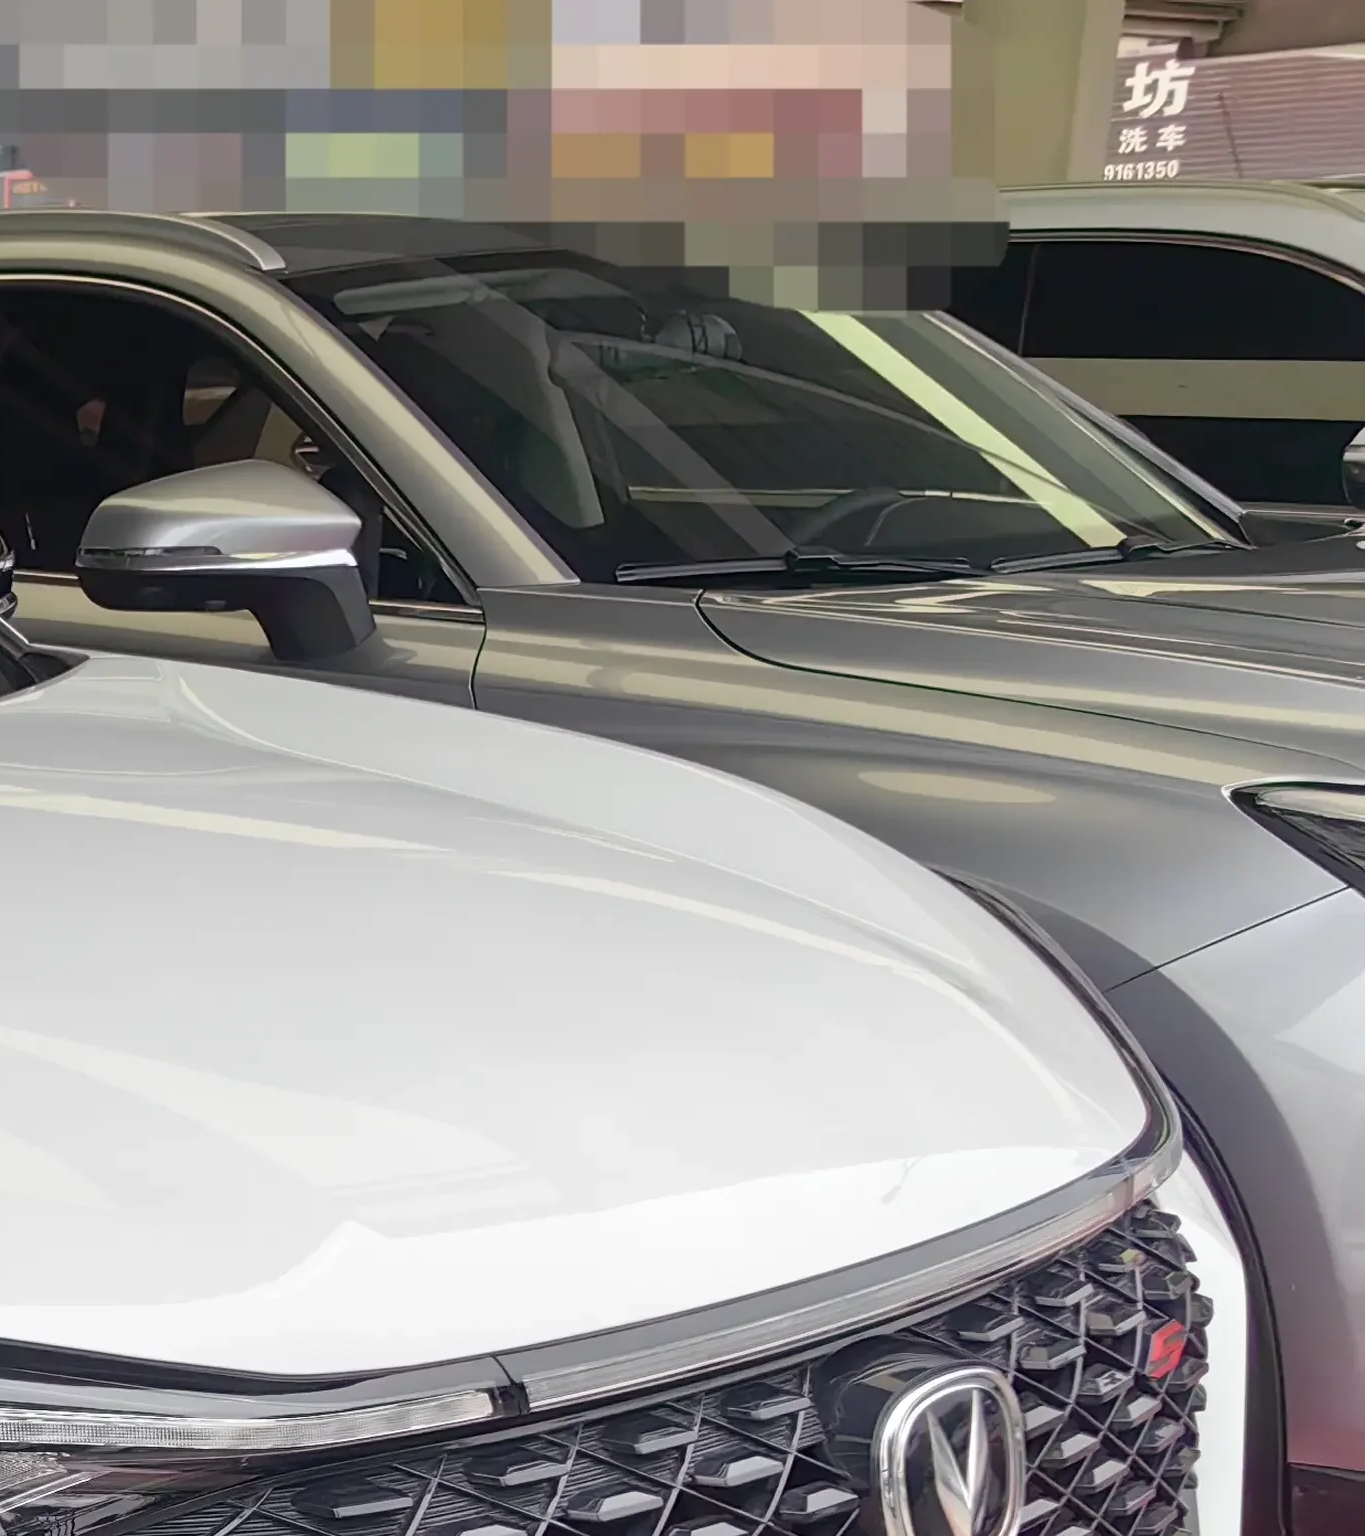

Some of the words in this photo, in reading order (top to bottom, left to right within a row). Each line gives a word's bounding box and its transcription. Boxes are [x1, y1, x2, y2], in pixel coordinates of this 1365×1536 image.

[1122, 58, 1196, 119] 坊
[1118, 123, 1187, 154] 洗车
[1146, 1319, 1185, 1380] S
